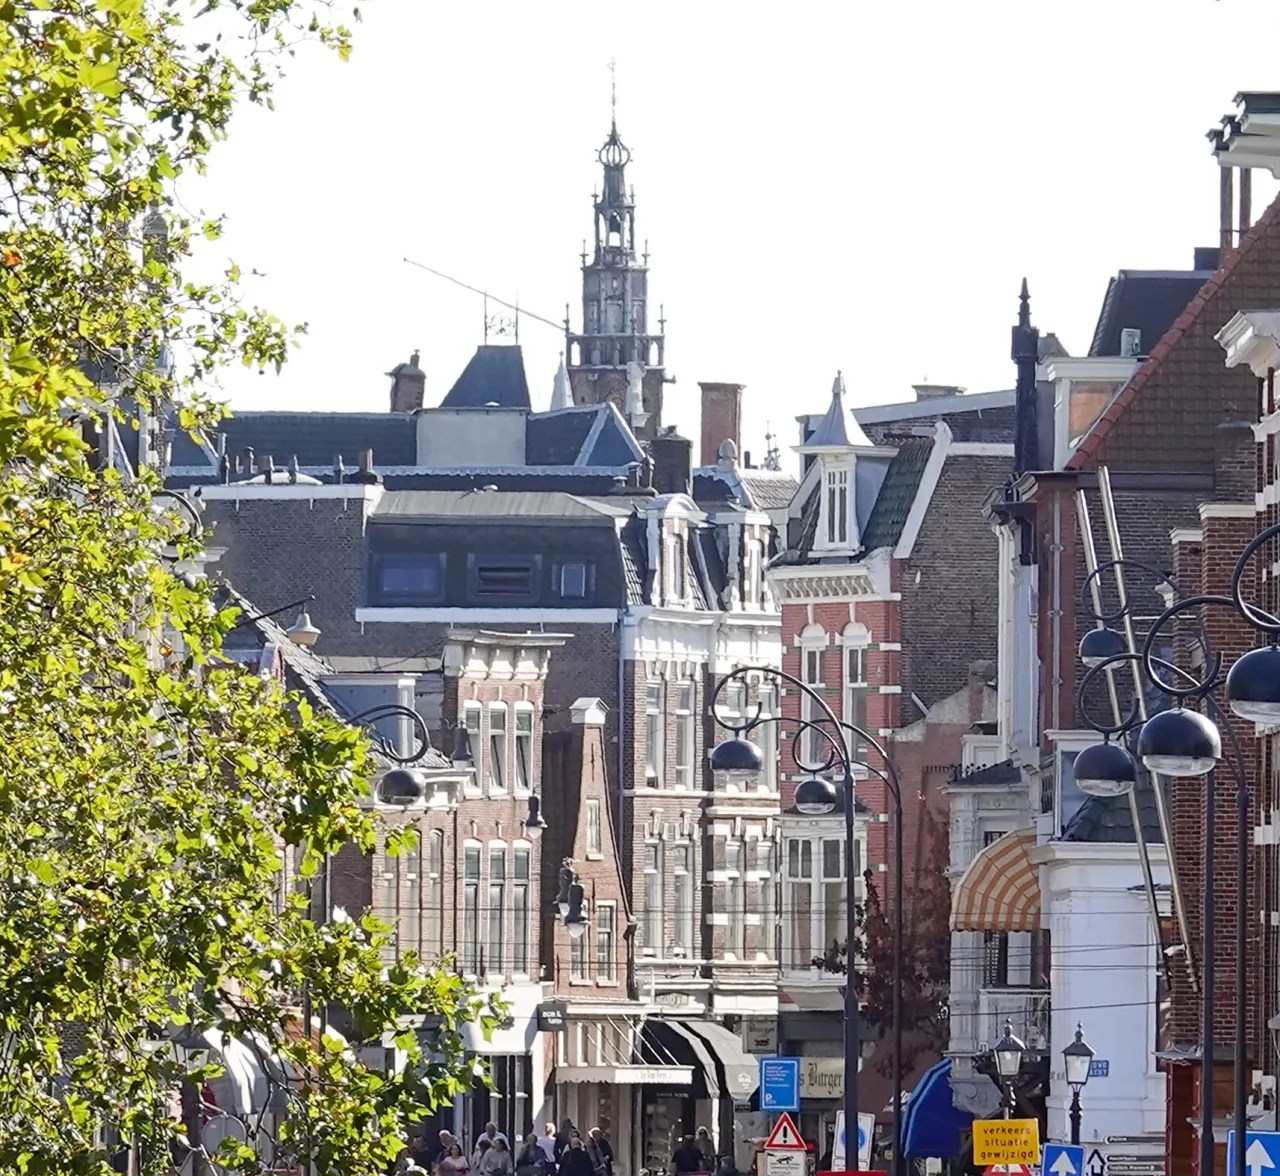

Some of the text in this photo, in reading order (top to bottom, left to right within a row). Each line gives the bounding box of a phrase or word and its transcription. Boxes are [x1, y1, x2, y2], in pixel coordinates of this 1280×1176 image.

[1089, 1069, 1108, 1077] ACHT
[807, 1062, 843, 1095] Burger
[983, 1126, 1031, 1135] verkeers
[985, 1137, 1029, 1146] situatie
[980, 1149, 1034, 1161] gewijzigd
